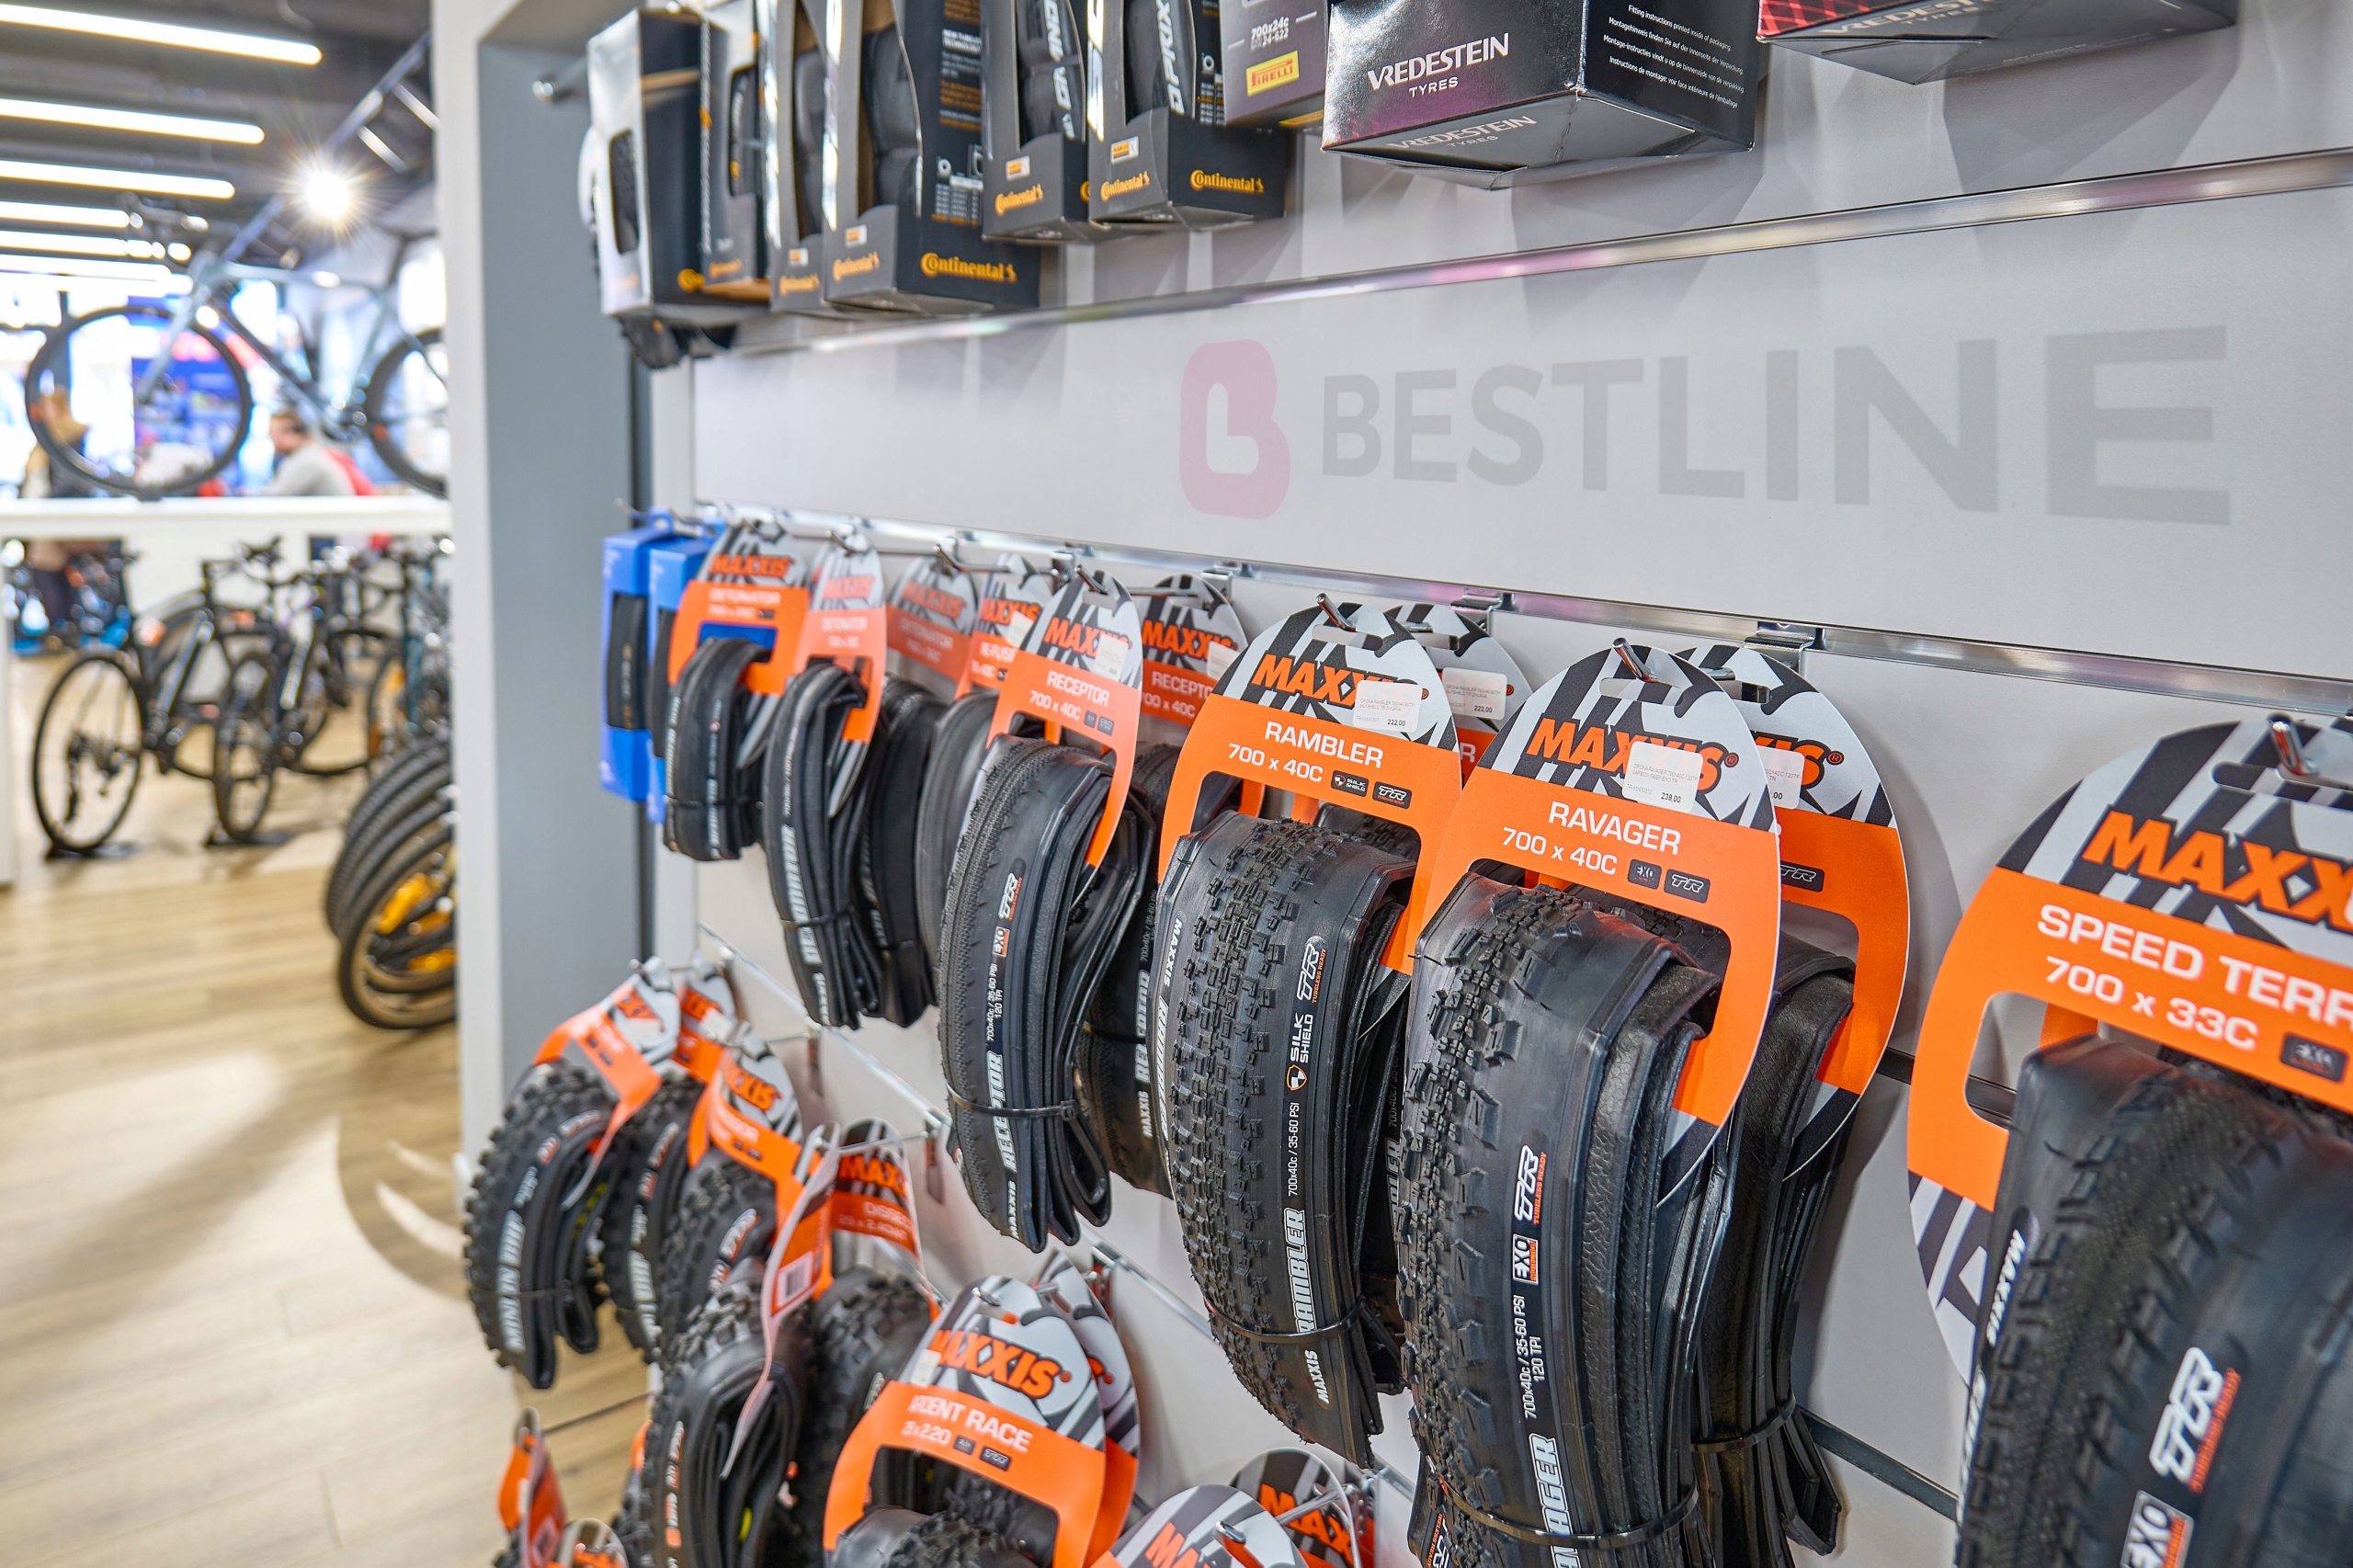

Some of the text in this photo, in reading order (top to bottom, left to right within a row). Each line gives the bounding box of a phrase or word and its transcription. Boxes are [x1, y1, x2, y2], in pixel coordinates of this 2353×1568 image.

[1608, 17, 1648, 38] Montagehinweis
[1649, 30, 1664, 43] finden
[1628, 5, 1644, 17] Fitting
[1645, 10, 1673, 28] instructions
[1674, 22, 1690, 34] printed
[1156, 0, 1180, 86] PRIX
[1368, 32, 1509, 91] VREDESTEIN
[1603, 34, 1651, 58] Montage-instructies
[1669, 59, 1676, 68] op
[1676, 60, 1682, 69] de
[1251, 58, 1293, 86] PIRELLI
[1609, 55, 1638, 73] Instructions
[1638, 65, 1645, 75] de
[1409, 76, 1459, 97] TYRES
[1387, 116, 1537, 148] VREDESTEIN
[1447, 135, 1498, 147] TYRES
[1100, 174, 1142, 201] Continental
[1190, 170, 1254, 194] Continental
[921, 253, 1005, 281] Continental
[1322, 326, 2231, 526] BESTLINE
[1029, 690, 1083, 722] 700 x 40C
[1047, 670, 1110, 707] RECEPTOR
[1142, 691, 1161, 708] 00
[1171, 700, 1196, 718] 40C
[1152, 671, 1213, 699] RECEPTO
[1473, 705, 1493, 713] 222,00
[1228, 743, 1324, 782] 700 x 40C
[1264, 721, 1383, 768] RAMBLER
[1379, 785, 1407, 801] TR
[1661, 792, 1681, 803] 239,00
[1548, 801, 1681, 856] RAVAGER
[1503, 827, 1547, 856] 700
[1552, 846, 1565, 861] x
[1570, 846, 1619, 876] 40C
[1672, 874, 1704, 892] TR
[1780, 864, 1816, 882] TR
[2082, 811, 2353, 929] MAXX
[999, 873, 1017, 919] TR
[994, 927, 1006, 954] EXO
[1164, 918, 1183, 986] MAXXIS
[990, 963, 998, 976] PSI
[1297, 943, 1319, 1001] TR
[1312, 949, 1326, 1004] TUBELESS READY
[2037, 903, 2353, 1031] SPEED TERR
[995, 989, 1004, 1001] TPI
[2046, 956, 2259, 1051] 700 x 33C
[1290, 1012, 1304, 1062] SILK
[1300, 1014, 1313, 1063] SHIELD
[987, 1051, 1017, 1173] RECETOR
[1138, 1091, 1153, 1138] MAXXIS
[1290, 1102, 1300, 1118] PSI
[1289, 1119, 1299, 1149] 35-60
[1288, 1156, 1298, 1197] 700x40c
[1515, 1145, 1540, 1221] TR
[1533, 1152, 1547, 1225] TUBELESS READY
[1284, 1208, 1317, 1333] RAMBLER
[1515, 1235, 1530, 1278] EXO
[1513, 1295, 1526, 1313] PSI
[1515, 1312, 1529, 1356] 35-60
[1304, 1349, 1330, 1404] MAXXIS
[1529, 1335, 1545, 1383] 120 TPI
[1518, 1368, 1538, 1419] 700x40c
[2149, 1346, 2223, 1483] TR
[965, 1408, 1033, 1454] RACE
